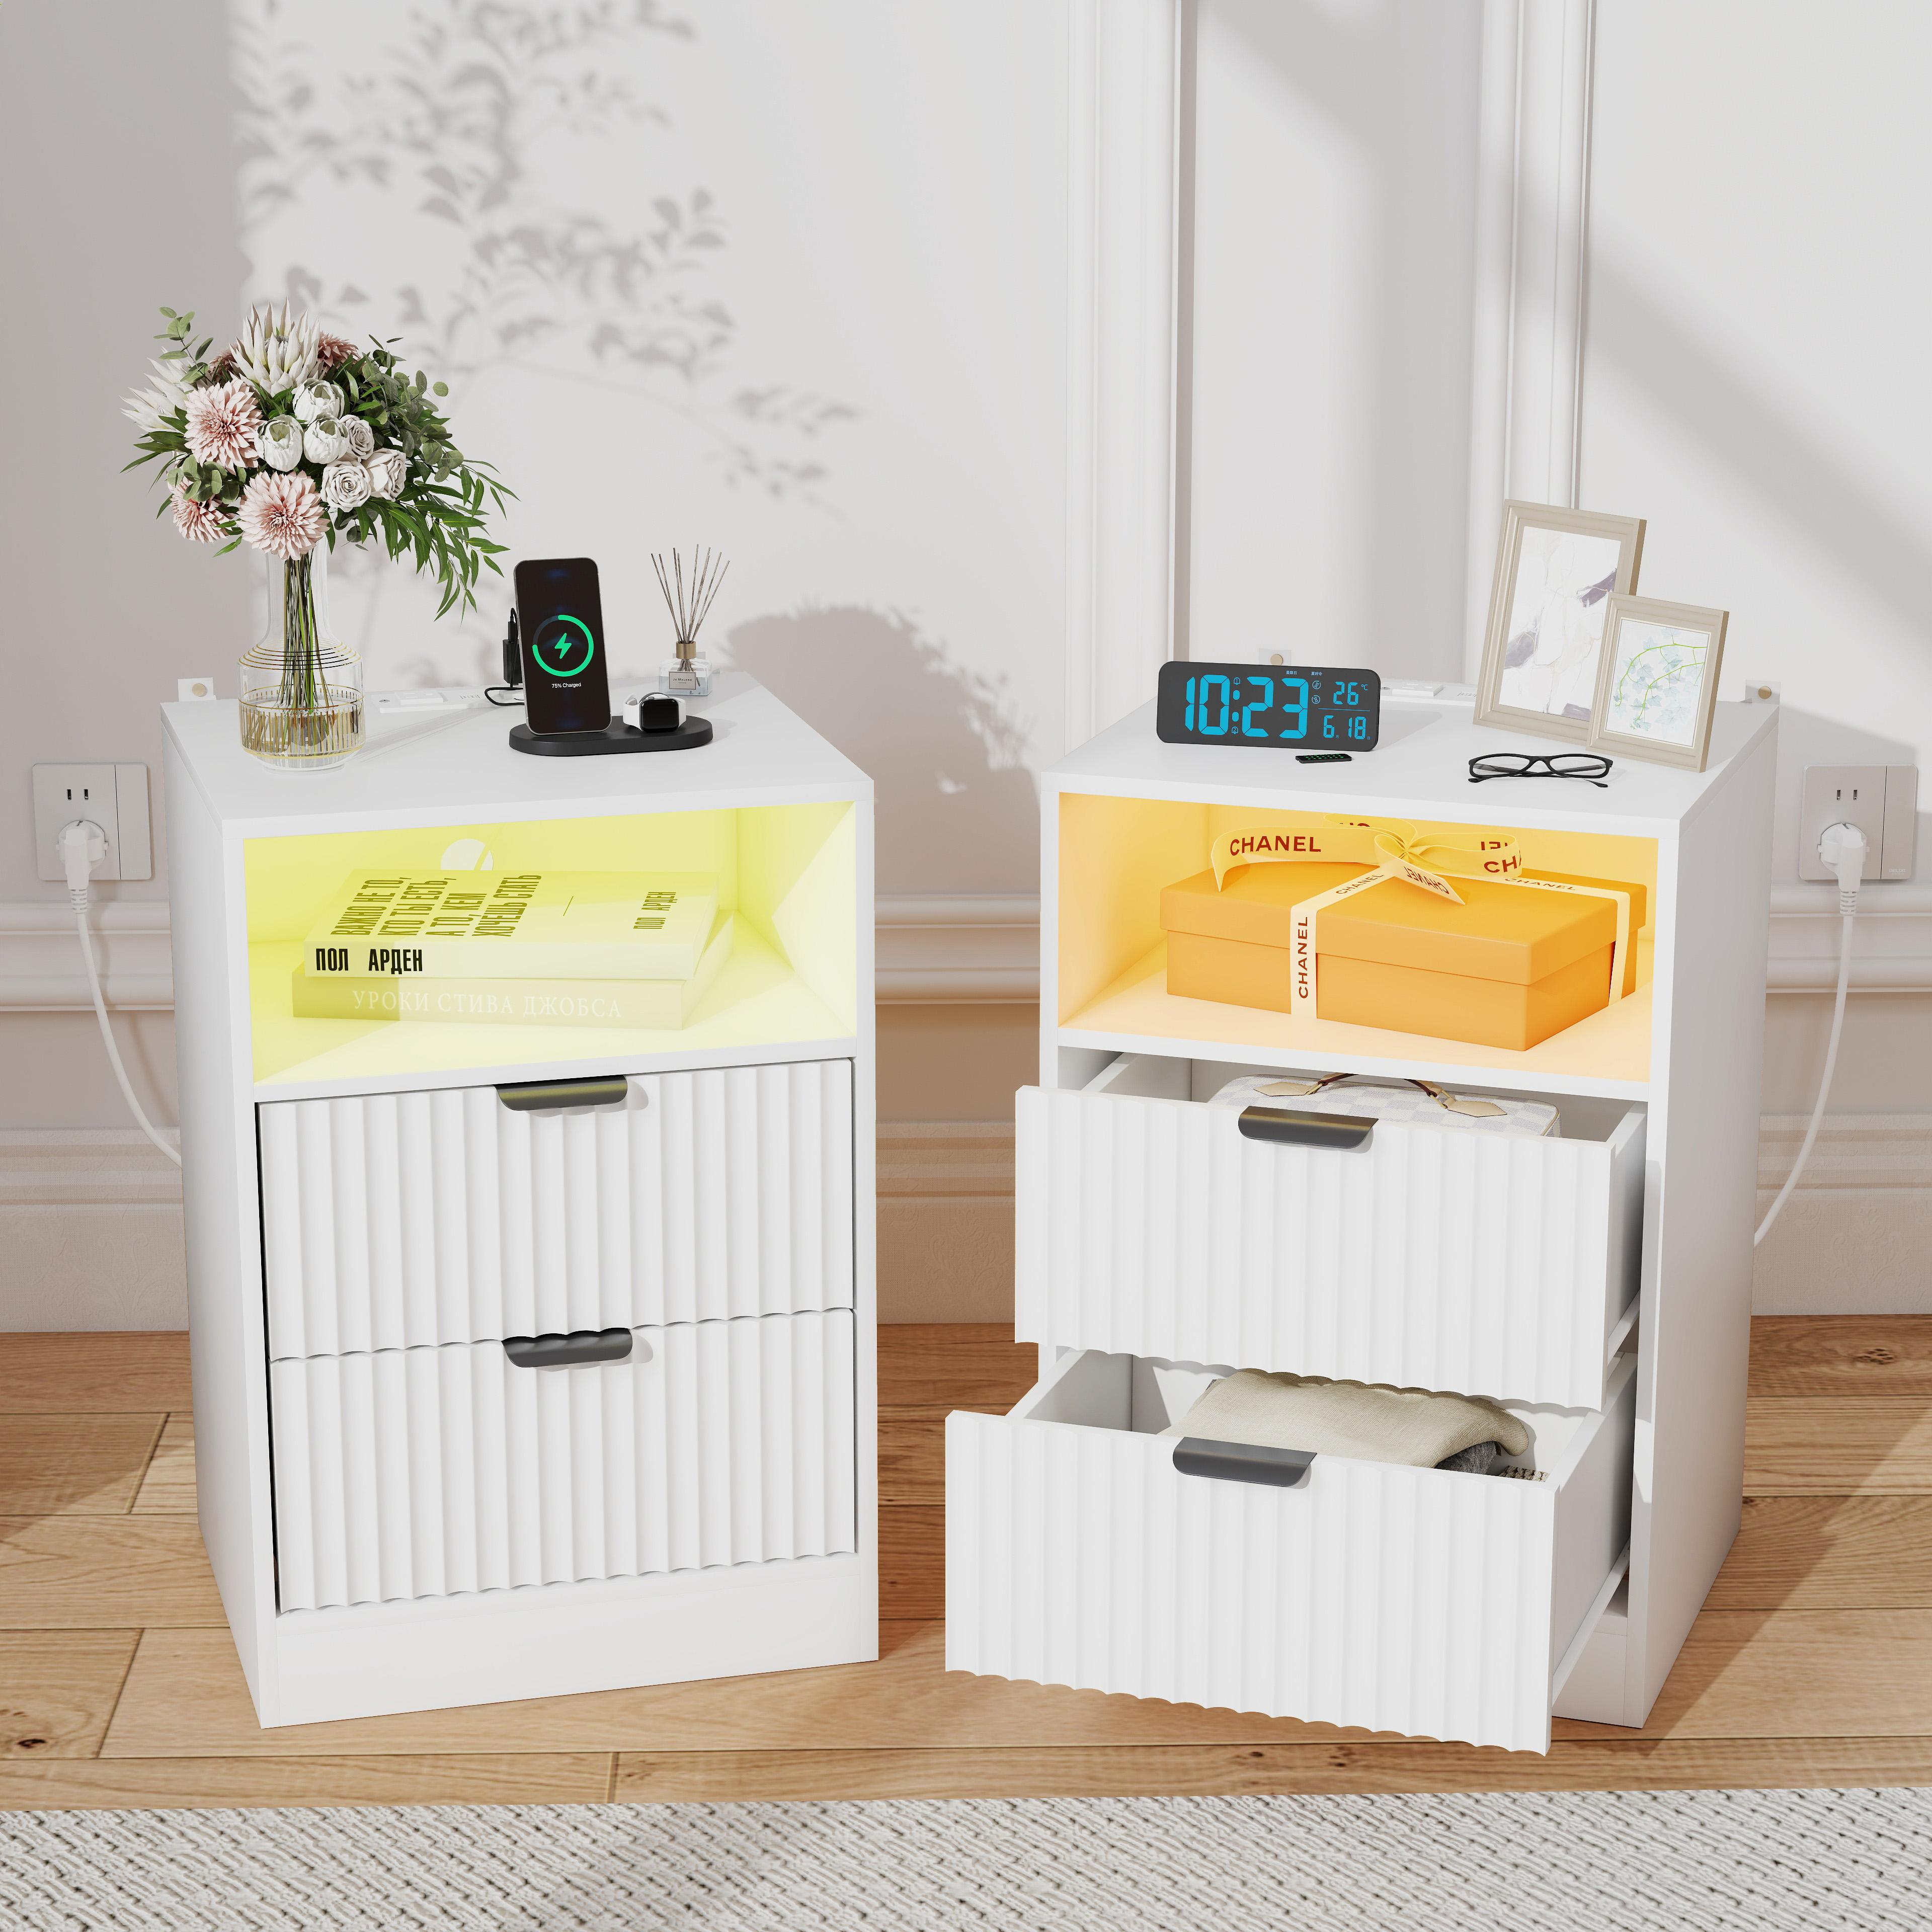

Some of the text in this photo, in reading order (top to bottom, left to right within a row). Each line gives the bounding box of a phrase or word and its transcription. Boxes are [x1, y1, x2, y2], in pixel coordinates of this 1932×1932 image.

[1185, 674, 1309, 739] 10:23
[1230, 835, 1321, 856] CHANEL
[1484, 850, 1521, 873] CH
[1336, 873, 1385, 895] CHANEL
[1505, 878, 1576, 891] CHANEL
[330, 877, 412, 935] ВАЖНО НЕ ТО,
[377, 877, 457, 936] КТО ТЫ ЕСТЬ,
[440, 893, 487, 910] КЕМ
[471, 875, 542, 937] ХОЧЕШЬ СТАТЬ
[633, 892, 678, 929] ПОЛ АРДЕН
[430, 914, 482, 927] ТО,
[315, 948, 423, 975] ПОЛ АРДЕН
[1298, 917, 1309, 999] CHANEL
[352, 990, 621, 1019] УРОКИ СТИВА ДЖОБСА
